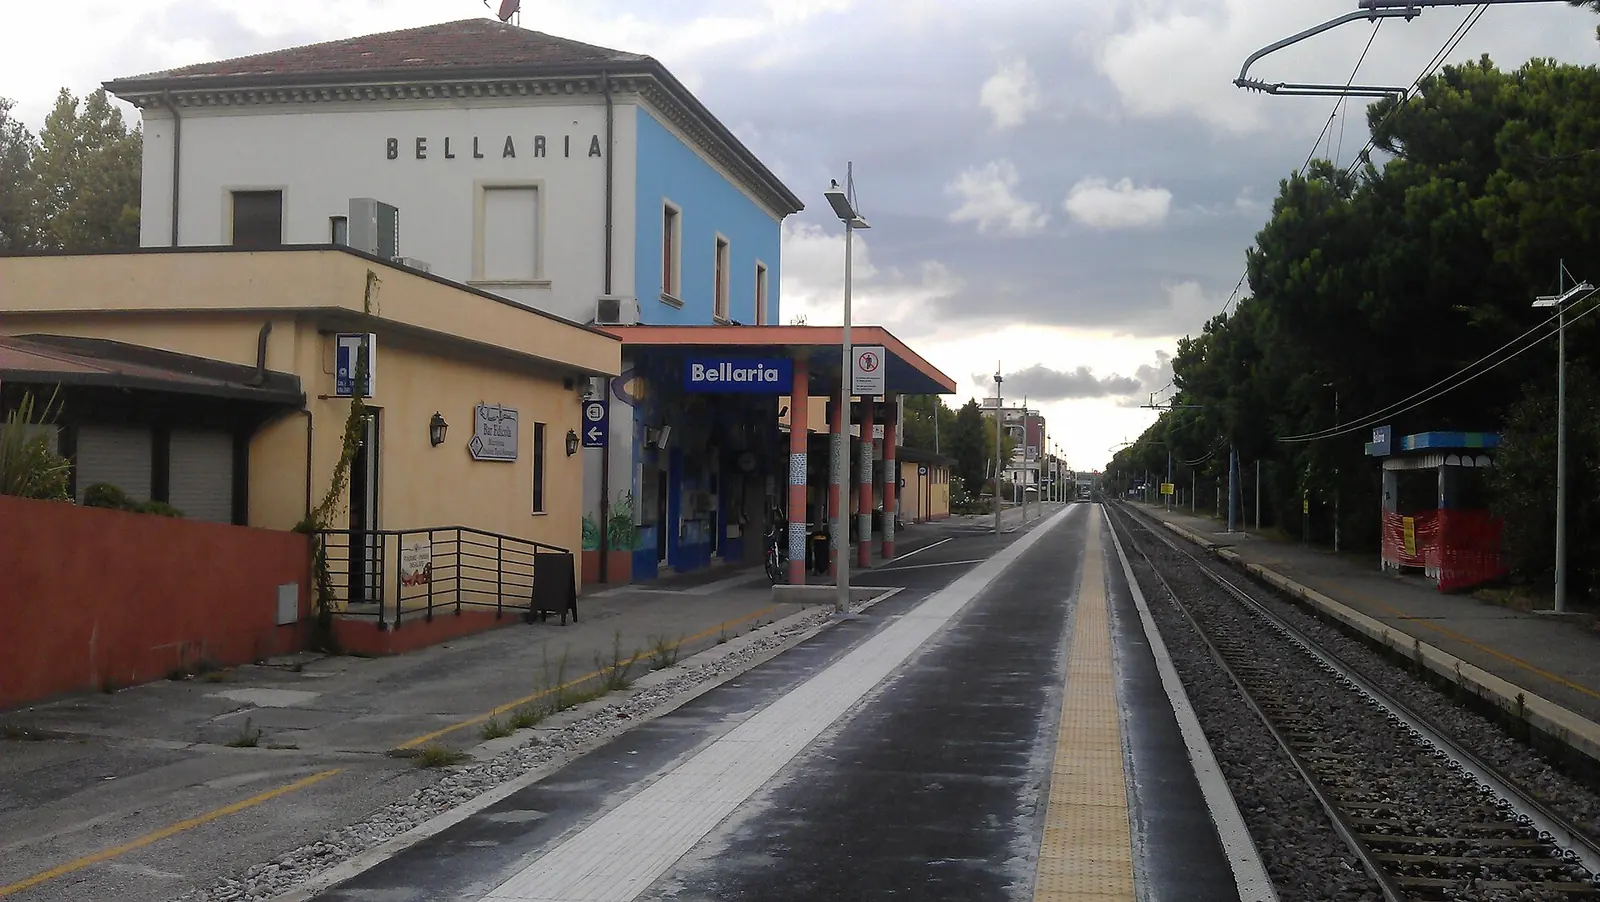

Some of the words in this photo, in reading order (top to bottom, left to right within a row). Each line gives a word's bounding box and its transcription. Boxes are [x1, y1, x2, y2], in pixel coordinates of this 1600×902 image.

[386, 135, 602, 160] BELLARIA
[340, 337, 367, 379] T
[691, 362, 779, 382] Bellaria
